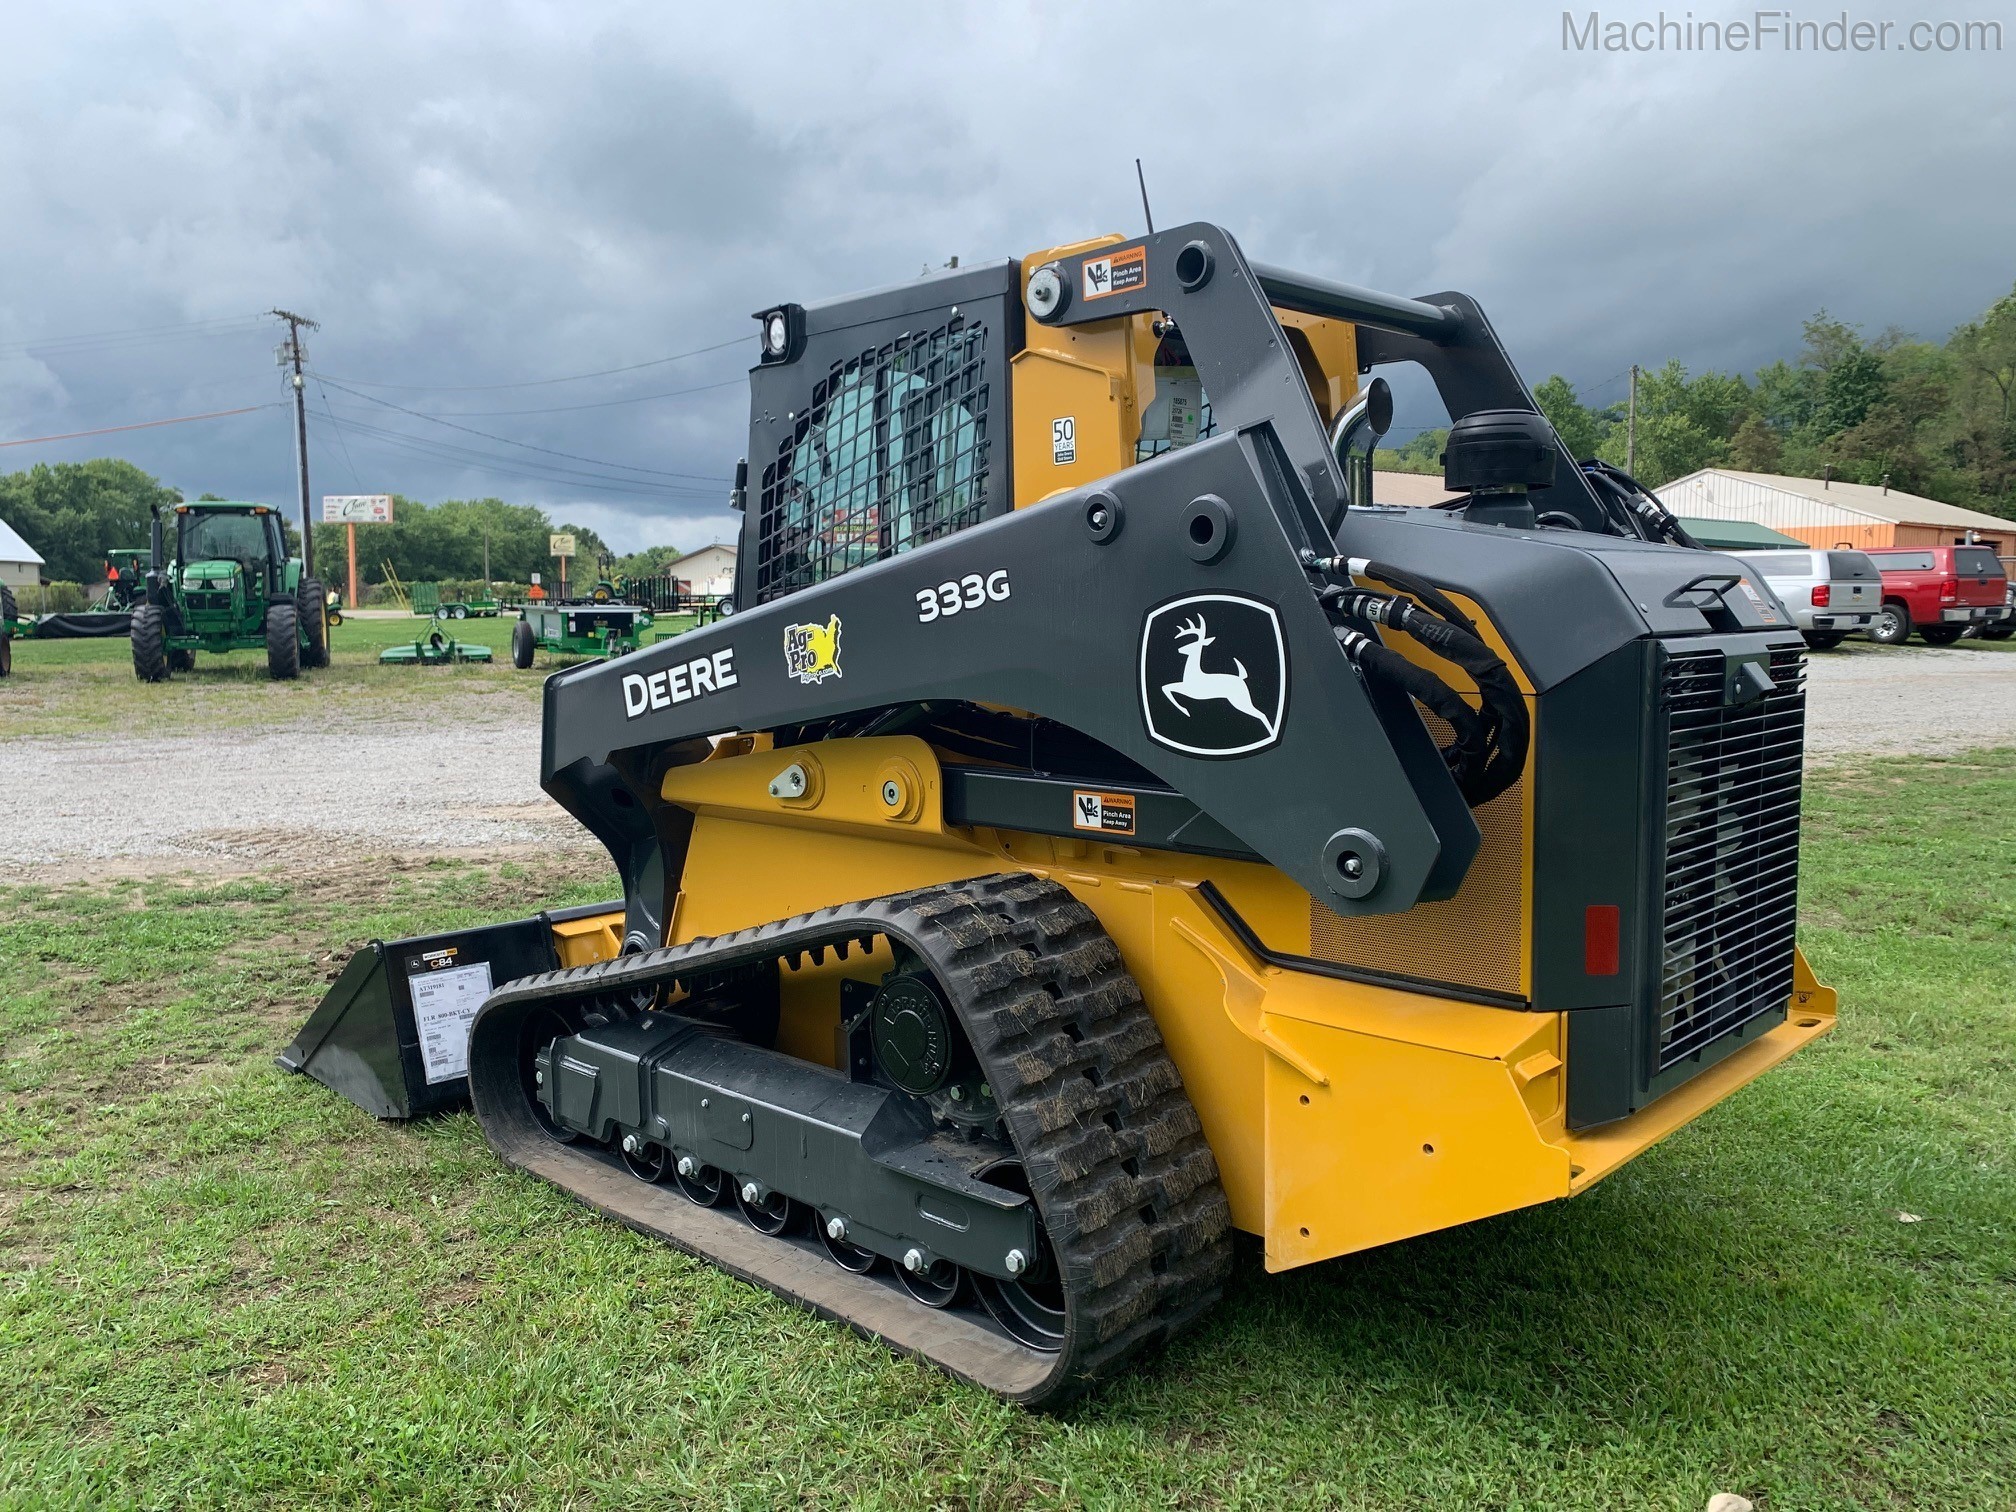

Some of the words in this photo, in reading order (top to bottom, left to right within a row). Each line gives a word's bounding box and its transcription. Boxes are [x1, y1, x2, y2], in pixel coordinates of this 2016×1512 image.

[1118, 251, 1143, 262] WARNING
[1112, 268, 1129, 278] Pinch
[1129, 265, 1142, 274] Area
[1112, 278, 1126, 286] Keep
[1125, 275, 1139, 284] Away
[1053, 419, 1074, 443] 50
[1054, 440, 1075, 451] YEARS
[915, 569, 1012, 623] 333G
[1369, 599, 1382, 616] TOP
[787, 628, 813, 653] Ag-
[789, 649, 817, 674] Pro
[621, 647, 739, 719] DEERE
[1108, 797, 1132, 805] WARNING
[430, 956, 453, 968] C84
